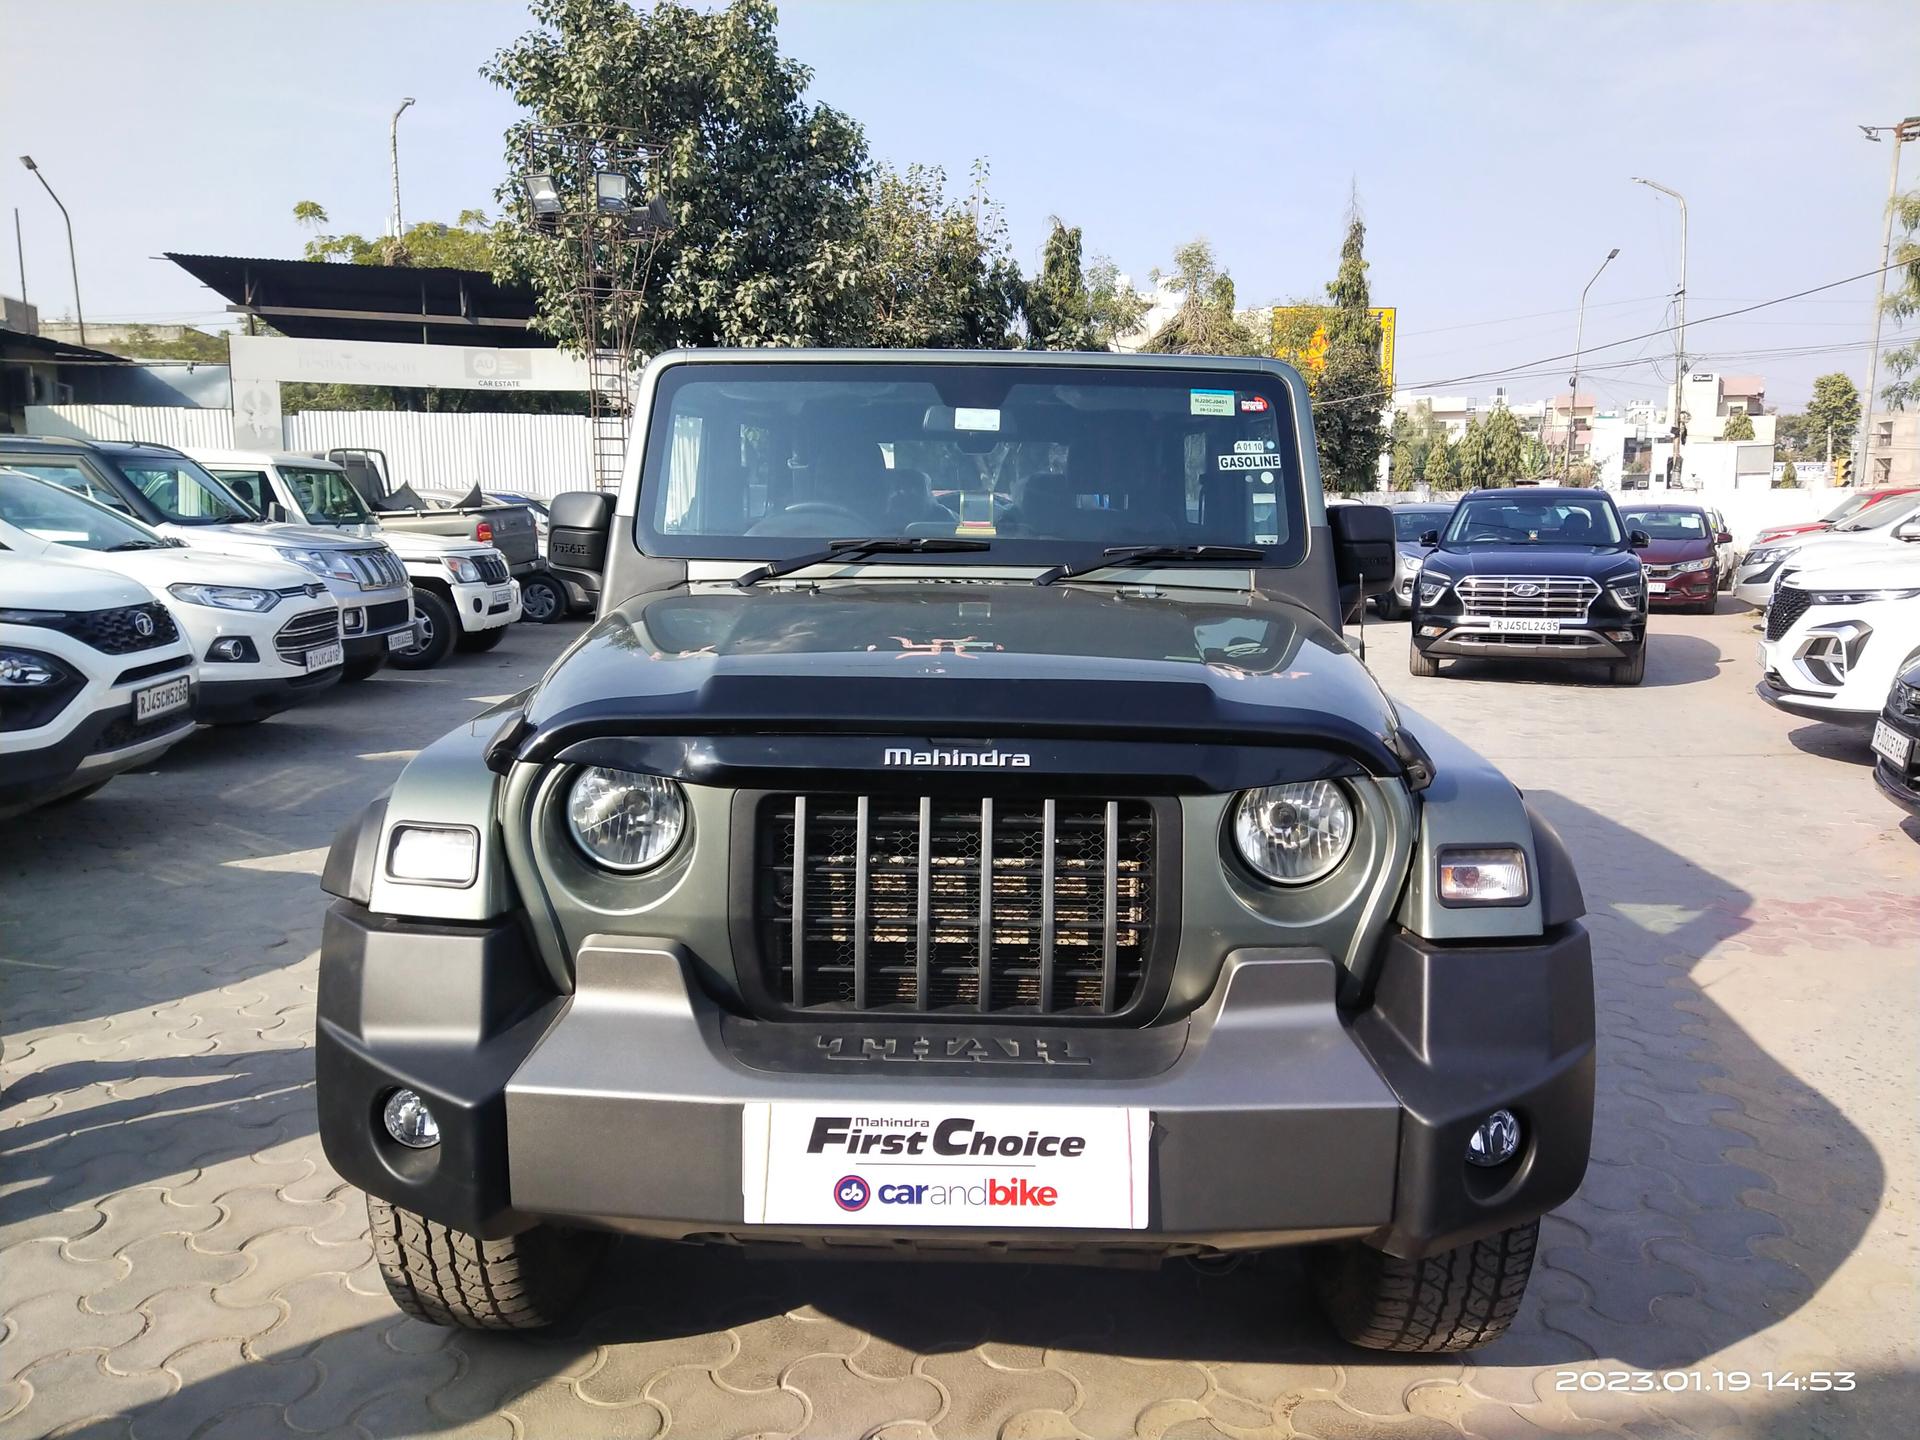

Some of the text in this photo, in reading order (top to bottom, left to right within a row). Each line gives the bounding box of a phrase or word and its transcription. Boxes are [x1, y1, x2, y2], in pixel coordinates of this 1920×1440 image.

[1236, 442, 1243, 451] A
[1220, 455, 1280, 469] GASOLINE
[1497, 620, 1558, 631] RJ45CL2435
[883, 748, 1031, 767] Mahindra
[815, 1034, 1094, 1066] THAR
[855, 1117, 930, 1128] Mahindra
[806, 1117, 1087, 1157] First Choice
[878, 1178, 1058, 1206] carandbike
